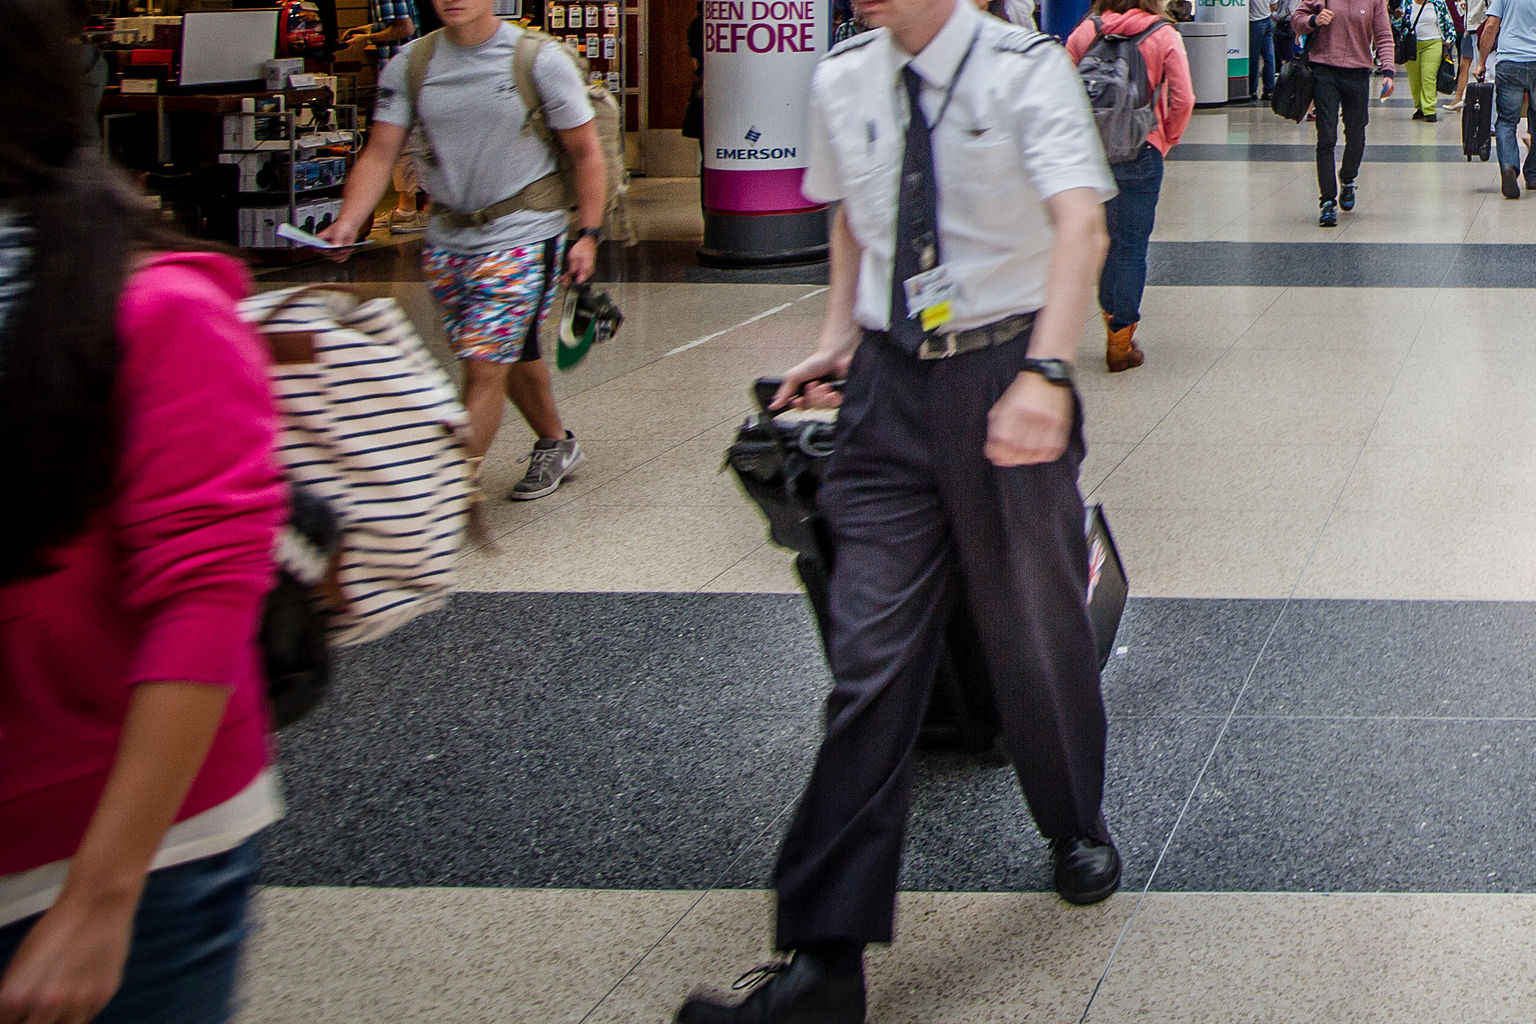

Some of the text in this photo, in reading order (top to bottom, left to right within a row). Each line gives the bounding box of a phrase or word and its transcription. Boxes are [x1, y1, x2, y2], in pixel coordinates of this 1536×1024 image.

[705, 1, 815, 21] BEEN DONE
[705, 22, 815, 53] BEFORE
[716, 147, 797, 160] EMERSON
